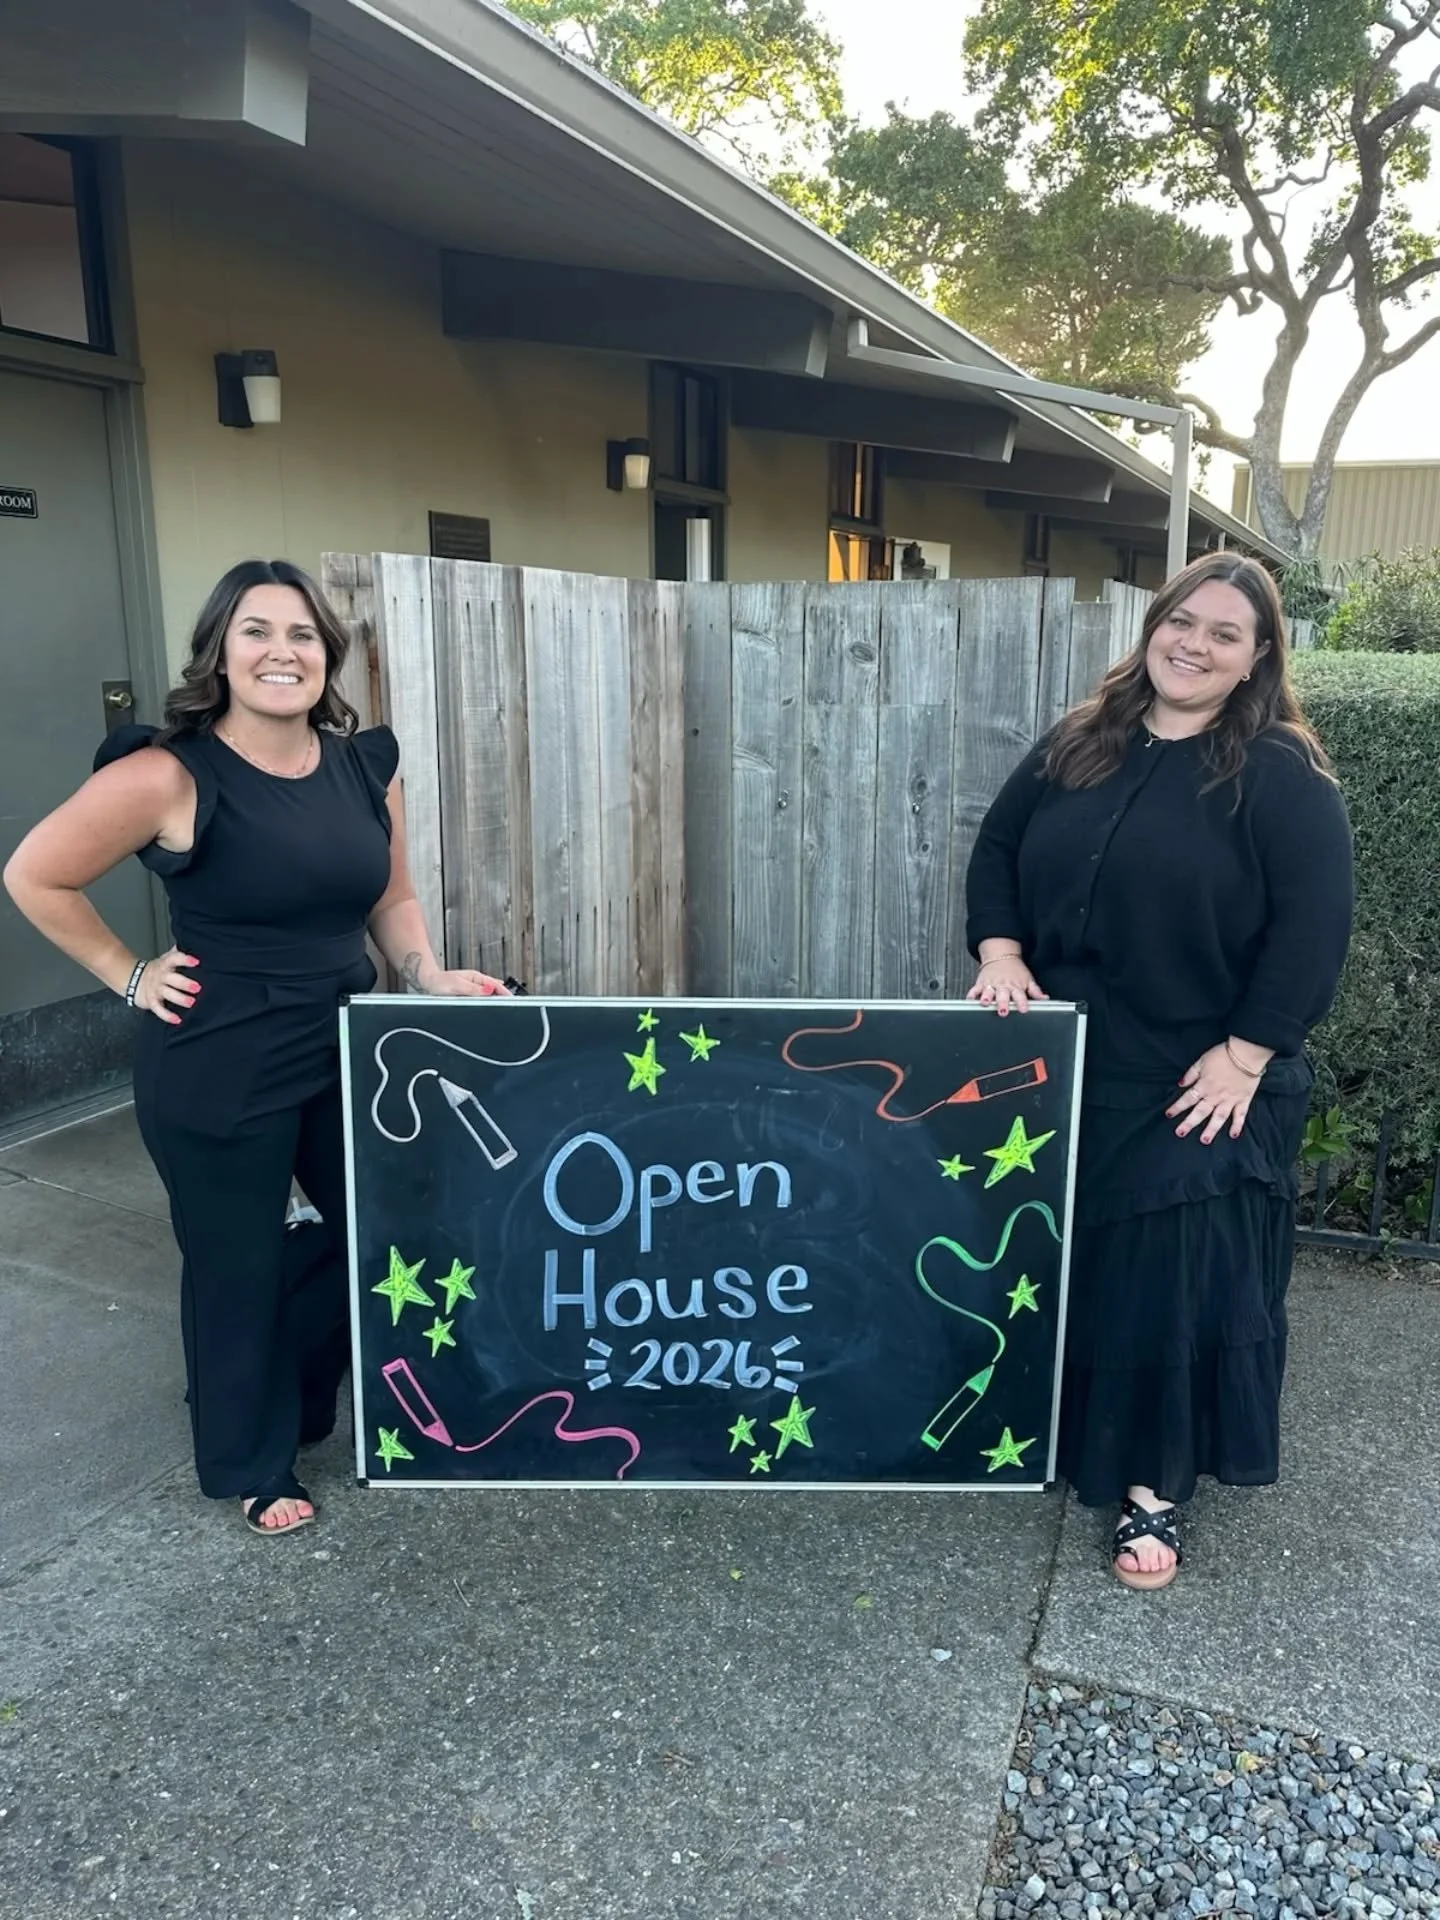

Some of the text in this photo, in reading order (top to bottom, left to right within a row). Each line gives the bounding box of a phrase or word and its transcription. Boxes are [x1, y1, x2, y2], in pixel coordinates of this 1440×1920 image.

[543, 1131, 792, 1253] Open
[543, 1248, 813, 1331] House
[622, 1338, 772, 1390] 2026
